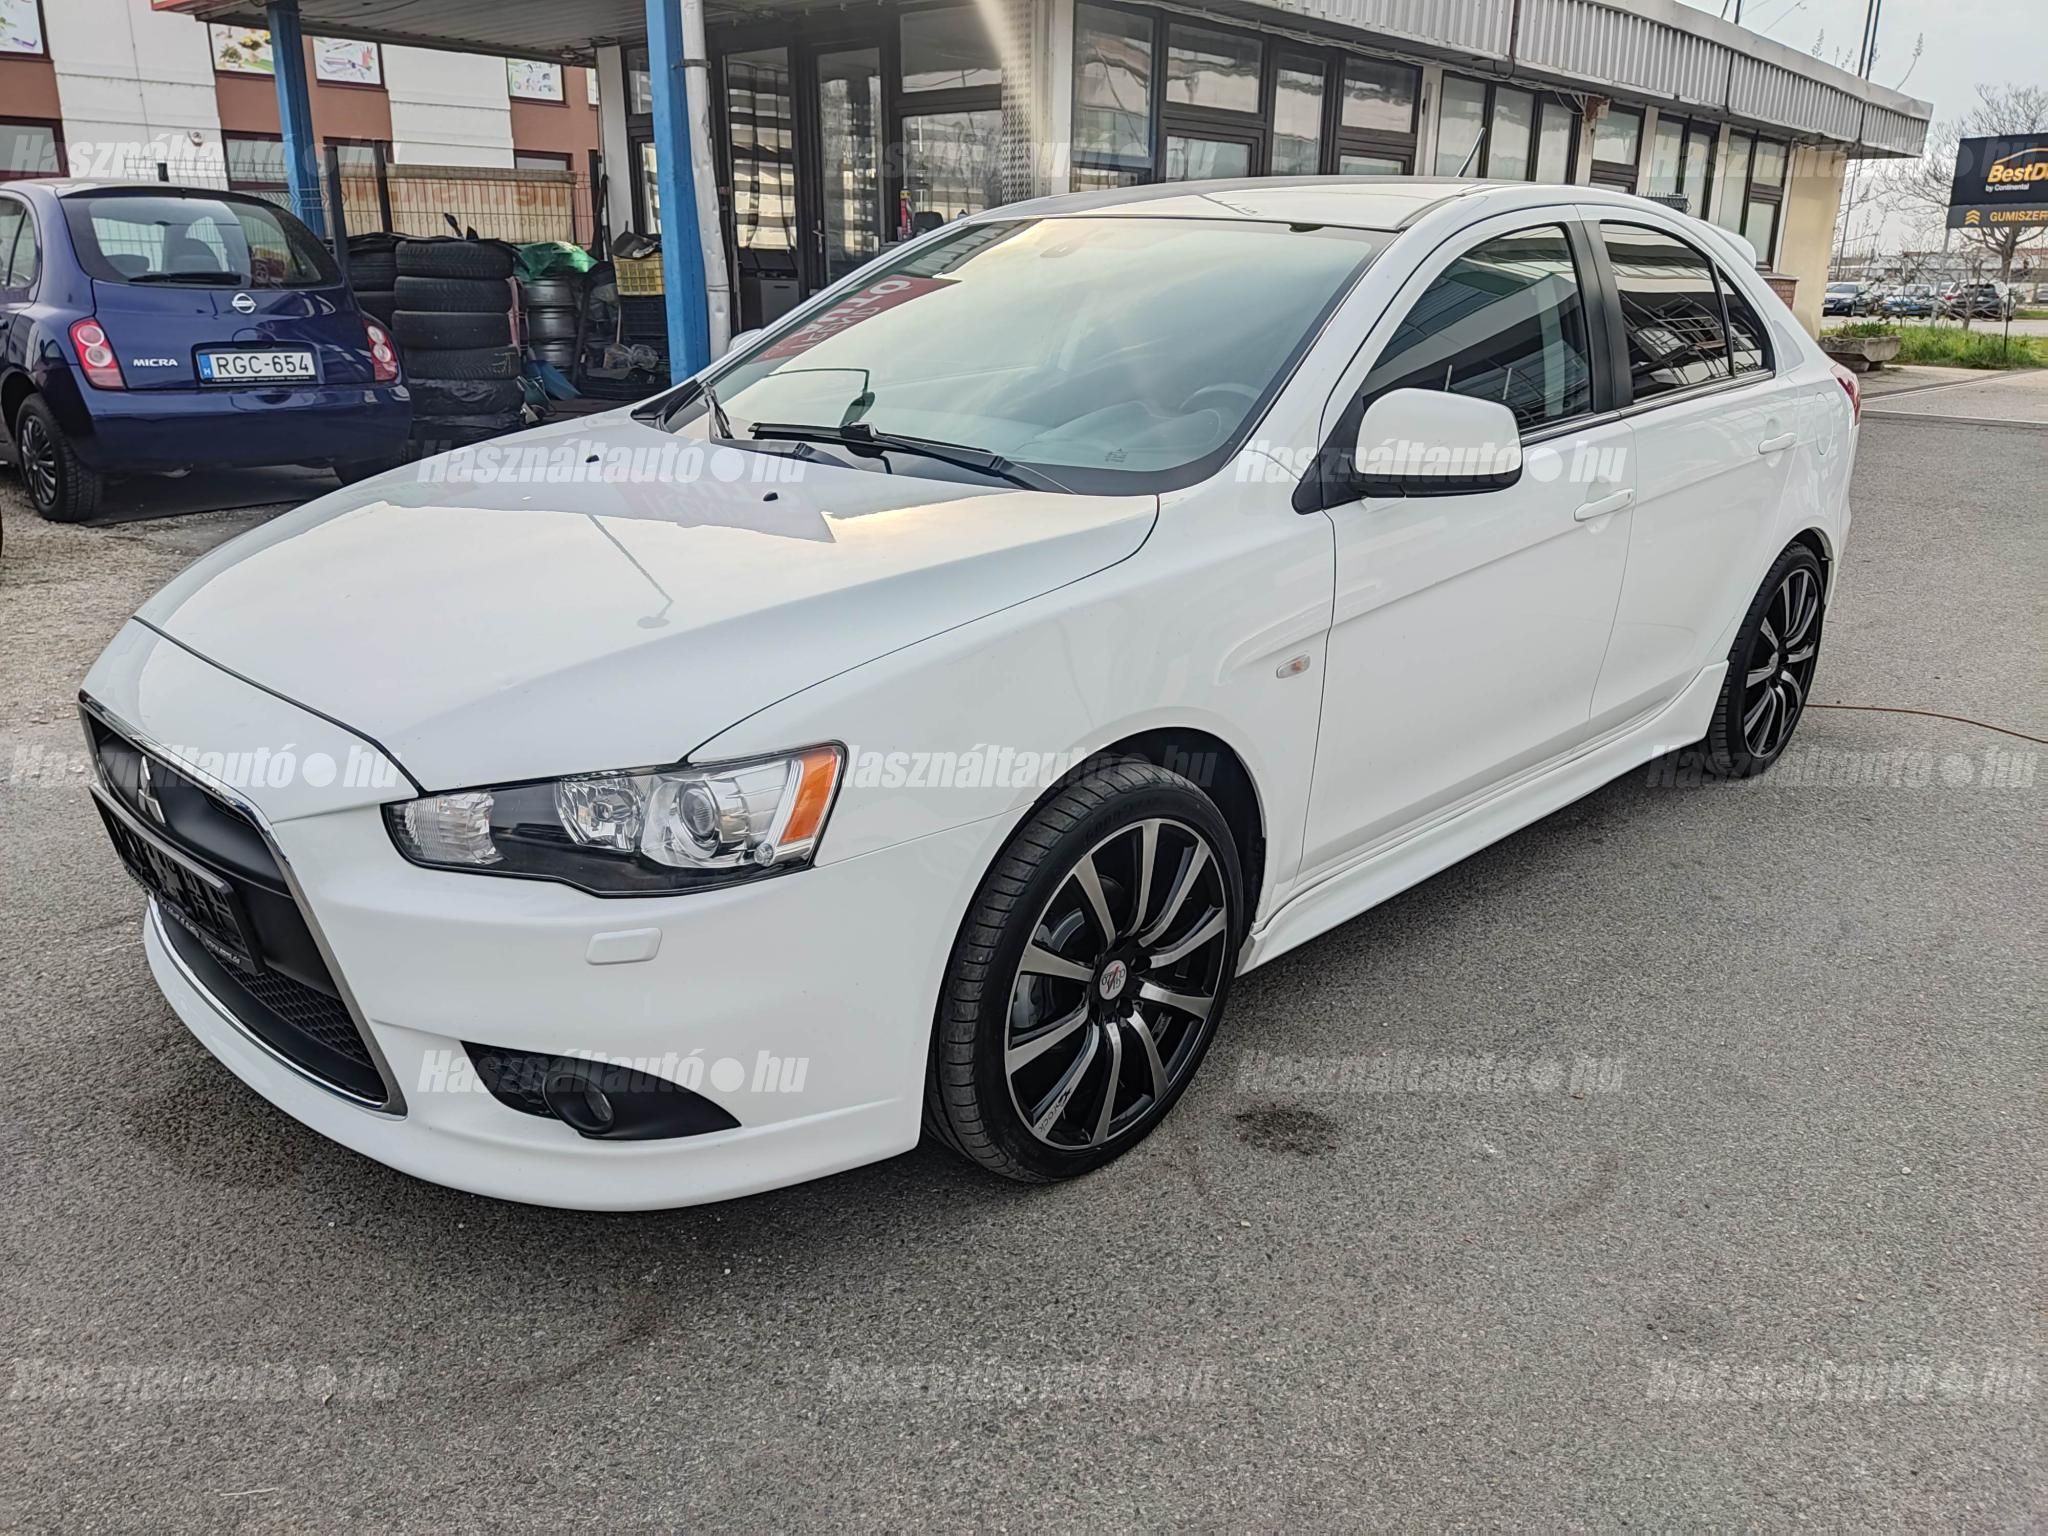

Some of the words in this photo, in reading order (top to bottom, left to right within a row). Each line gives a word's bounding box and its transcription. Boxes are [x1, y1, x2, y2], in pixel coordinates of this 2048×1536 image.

[1987, 162, 2048, 182] BestD
[1994, 183, 2030, 191] Continental
[133, 358, 178, 367] MICRA
[215, 354, 309, 376] RGC-654
